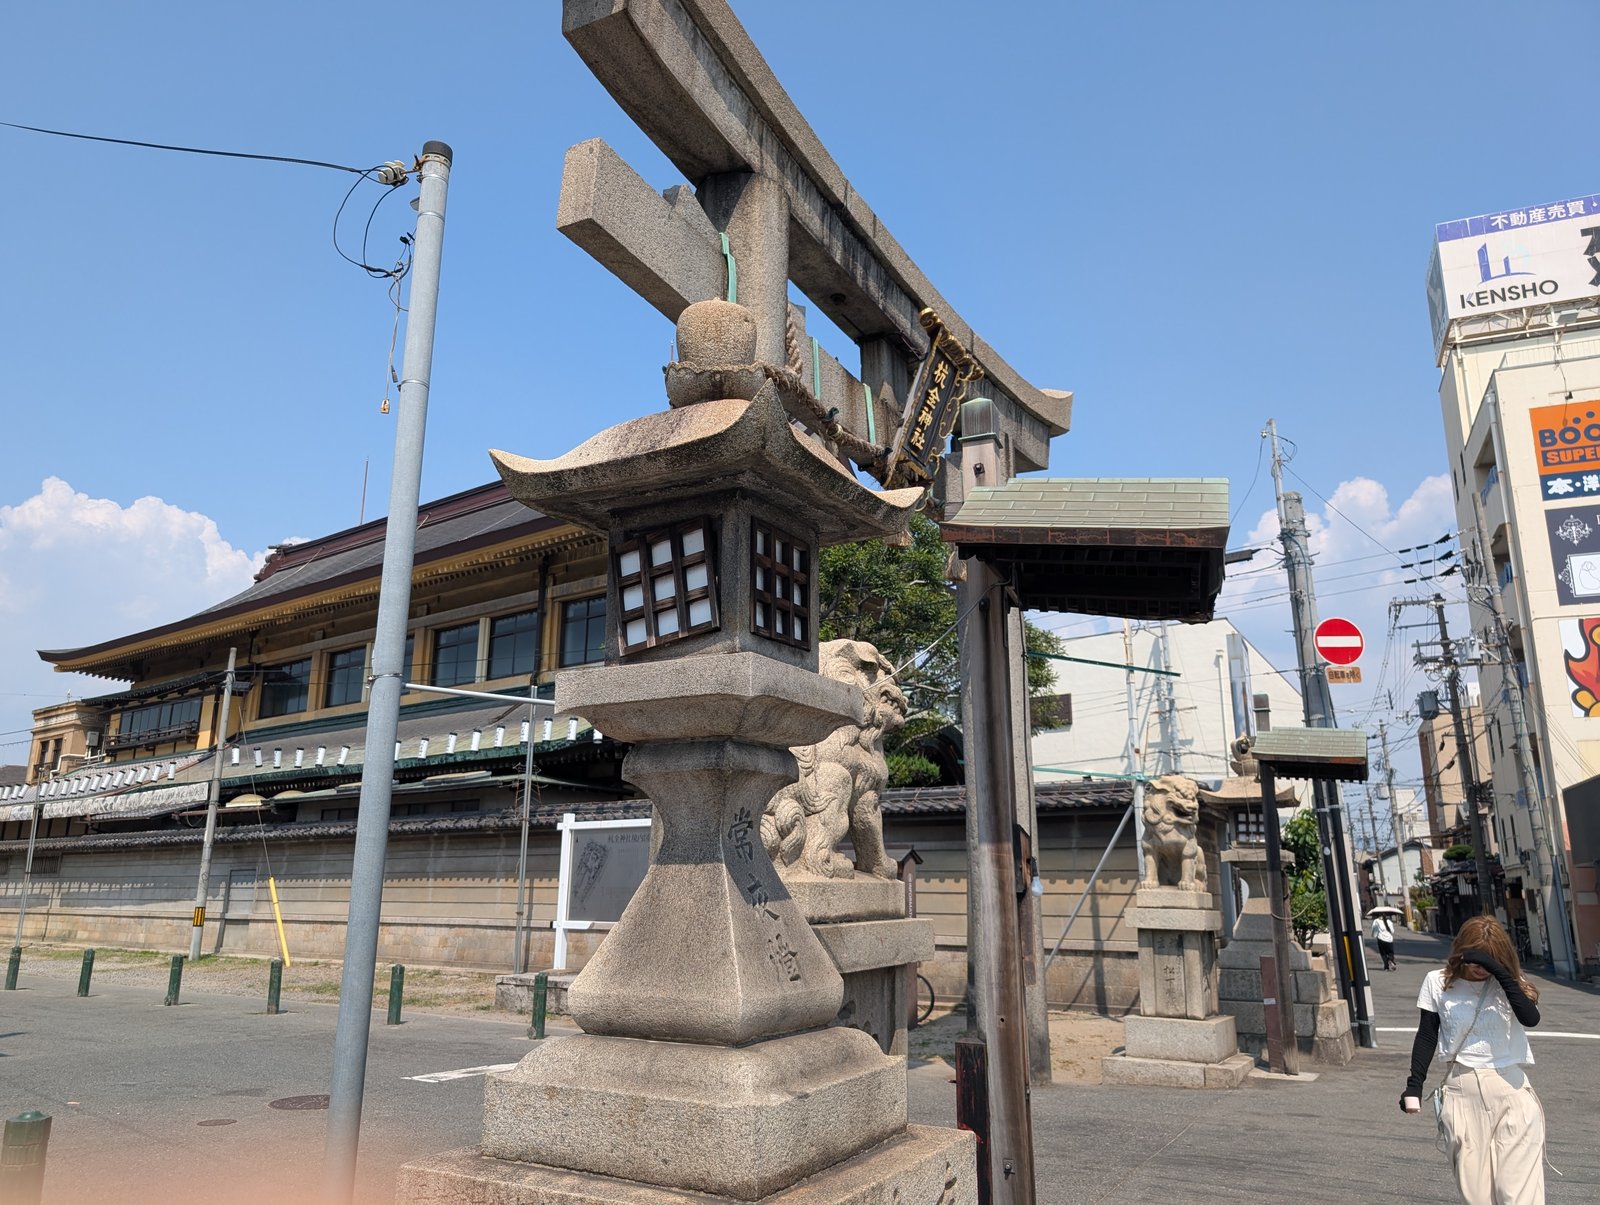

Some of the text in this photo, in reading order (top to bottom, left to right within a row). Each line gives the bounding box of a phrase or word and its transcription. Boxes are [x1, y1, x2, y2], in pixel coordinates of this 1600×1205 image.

[1460, 280, 1559, 309] KENSHO
[911, 361, 949, 450] 杭全神社
